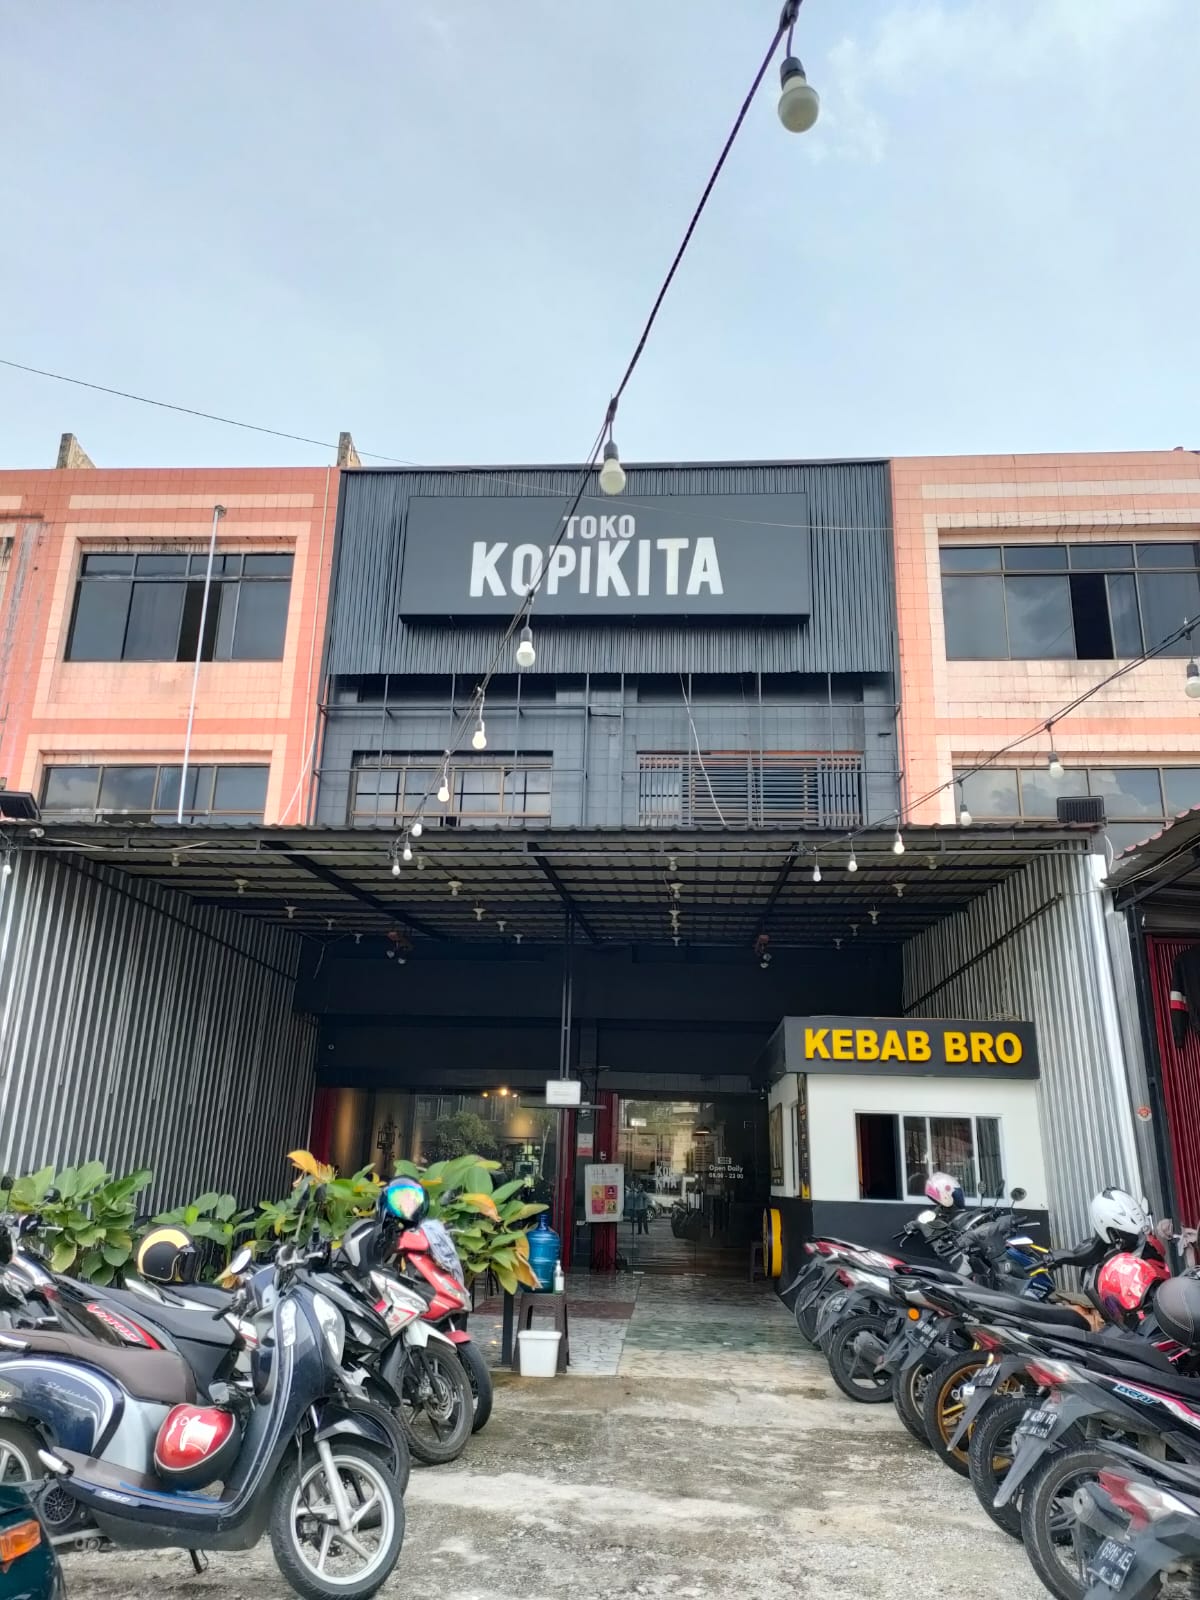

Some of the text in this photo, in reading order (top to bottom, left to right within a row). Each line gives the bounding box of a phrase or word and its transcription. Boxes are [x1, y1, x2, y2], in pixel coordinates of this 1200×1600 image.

[563, 514, 636, 539] TOKO
[804, 1028, 1023, 1064] KEBAB BRO
